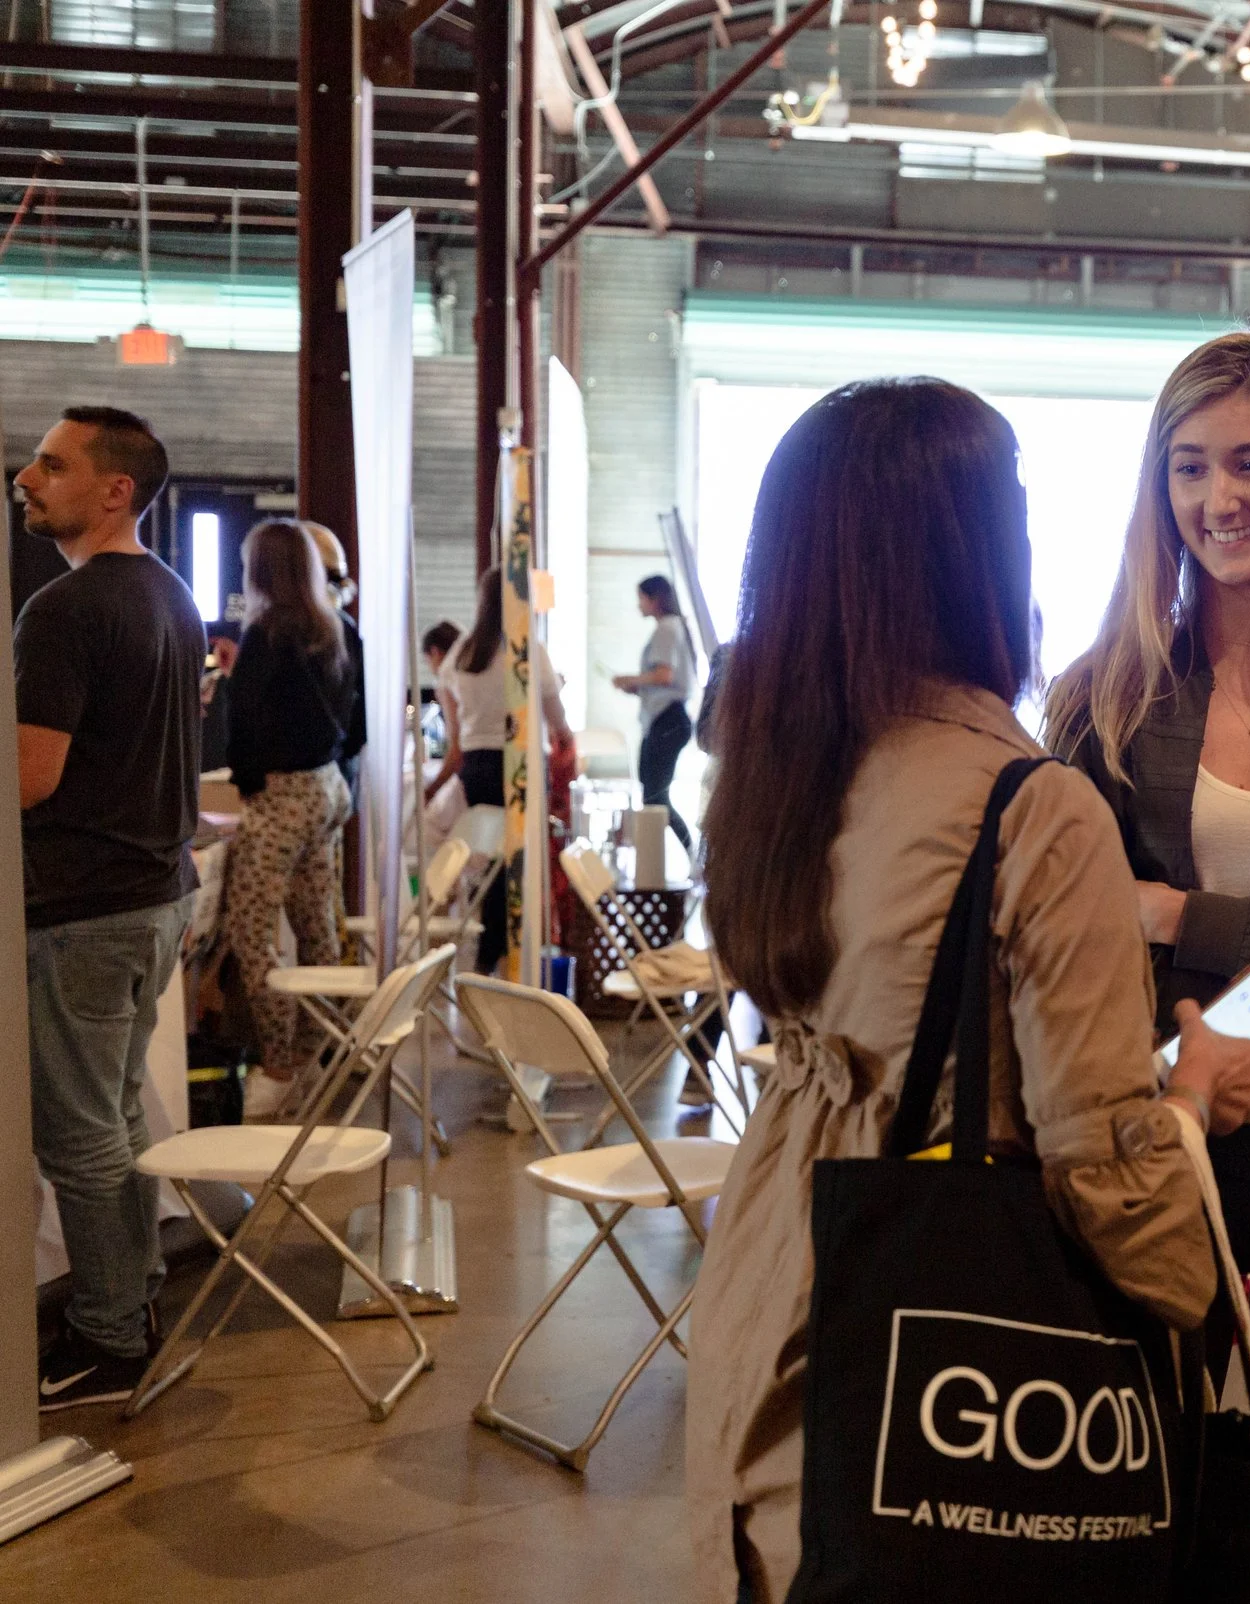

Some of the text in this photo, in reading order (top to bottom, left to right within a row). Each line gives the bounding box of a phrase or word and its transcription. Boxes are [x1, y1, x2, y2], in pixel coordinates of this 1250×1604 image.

[920, 1366, 1150, 1475] GOOD
[911, 1499, 934, 1527] A
[938, 1501, 1077, 1542] WELLNESS
